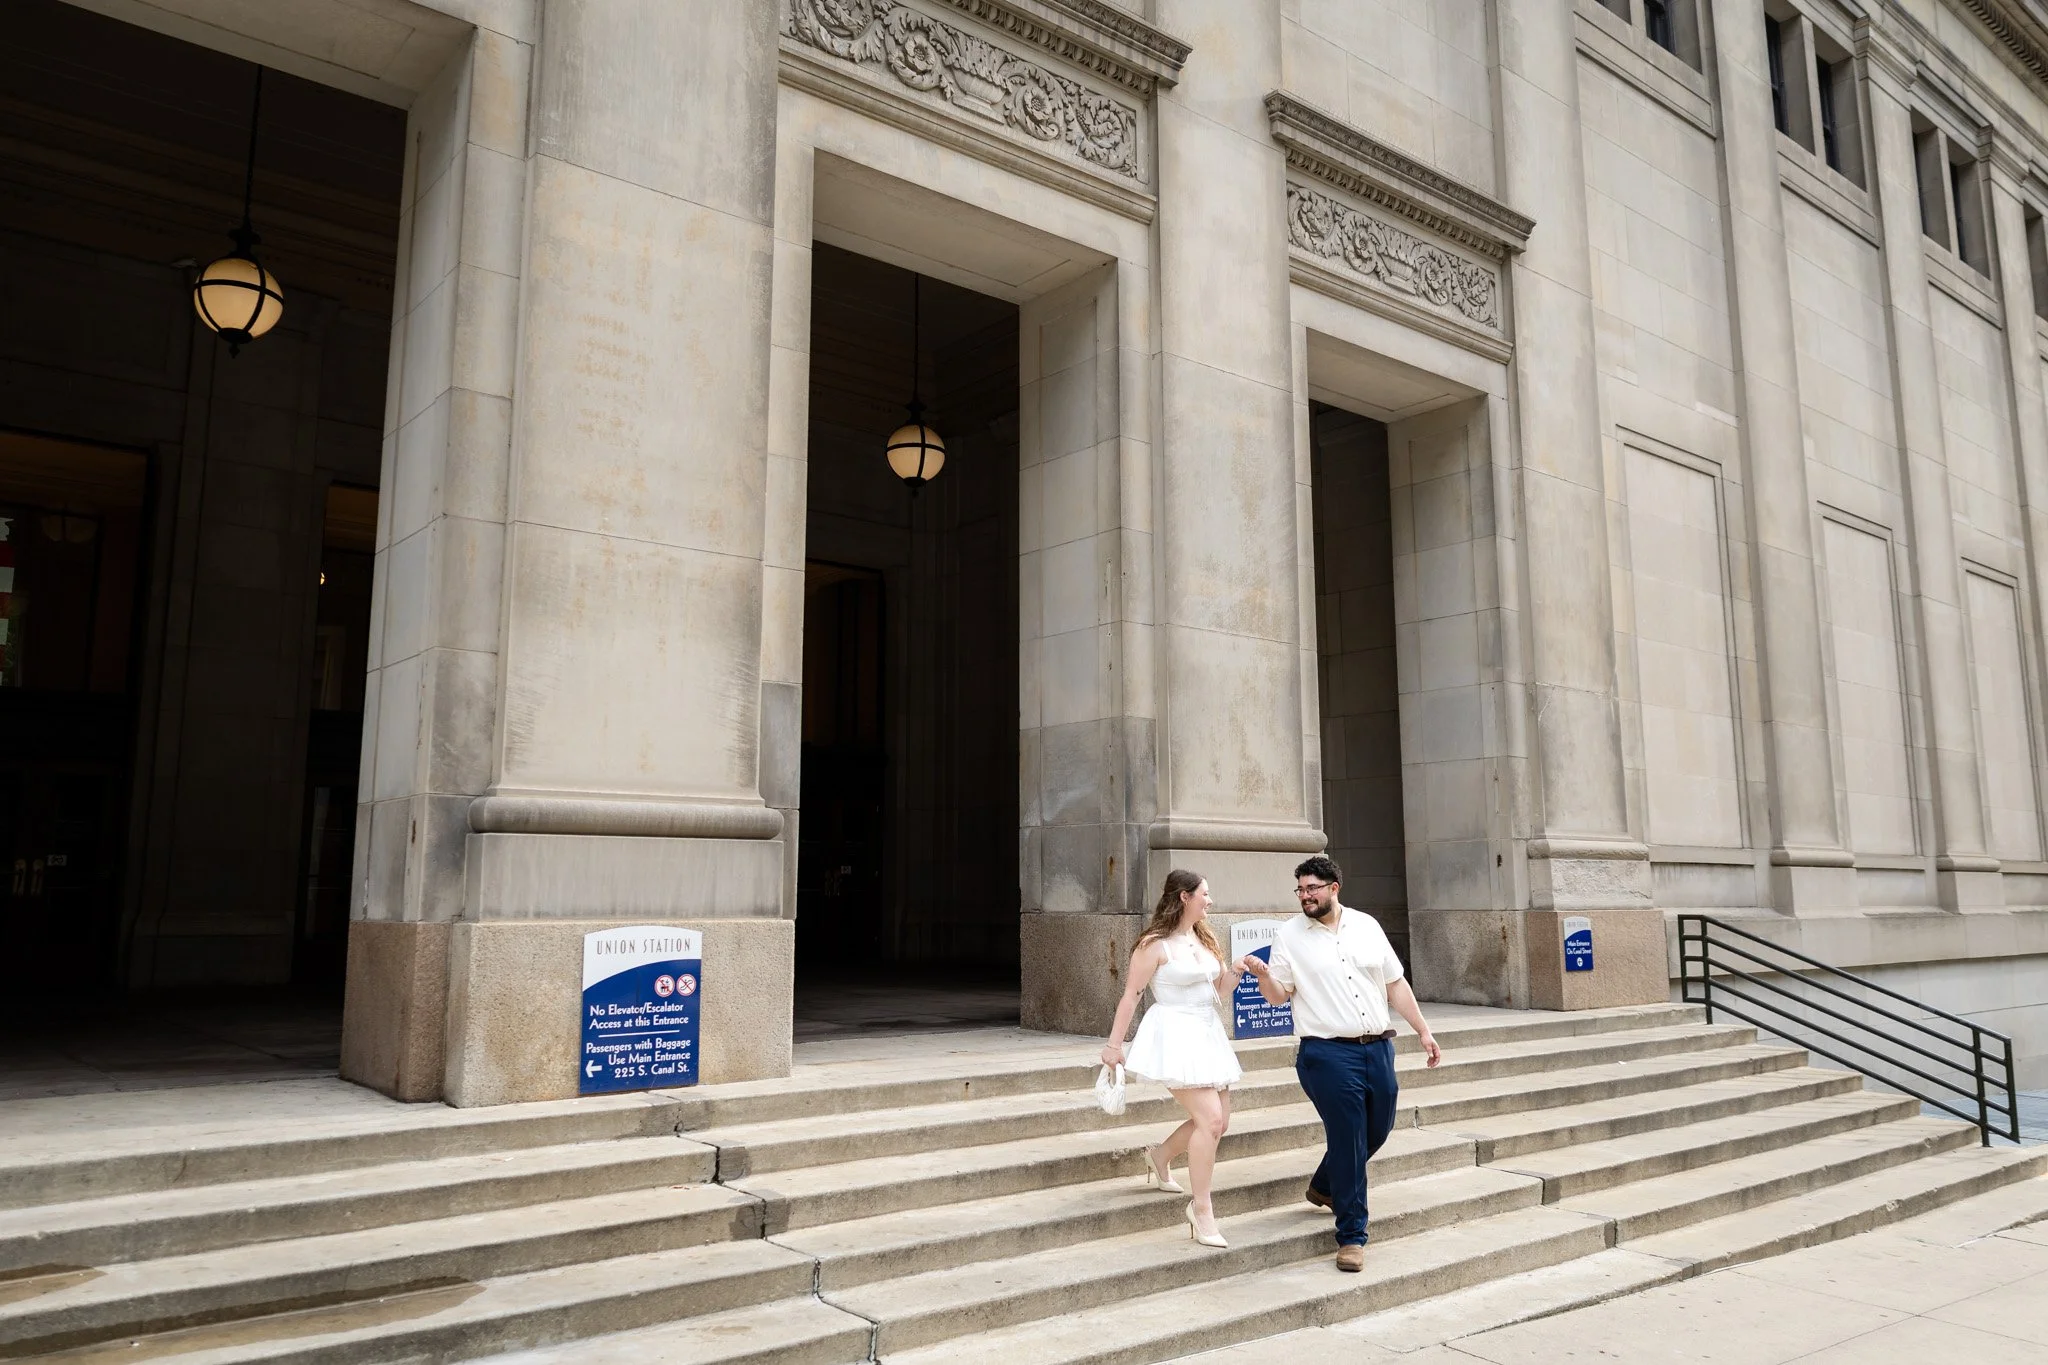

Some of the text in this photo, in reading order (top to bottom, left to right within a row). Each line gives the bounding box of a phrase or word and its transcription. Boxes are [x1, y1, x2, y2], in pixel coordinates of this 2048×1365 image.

[1237, 928, 1258, 940] UNION
[597, 938, 691, 955] UNION STATION
[1237, 985, 1254, 993] Access
[590, 1001, 684, 1016] No Elevator/Escalator
[1235, 1002, 1260, 1011] Passengers
[1248, 1009, 1291, 1019] Use Main Entrance
[589, 1015, 689, 1030] Access at this Entrance
[1252, 1020, 1263, 1028] 225
[1271, 1018, 1283, 1027] Canal
[586, 1037, 691, 1054] Passengers with Baggage
[608, 1050, 691, 1065] Use Main Entrance
[614, 1062, 690, 1078] 225 S. Canal St.
